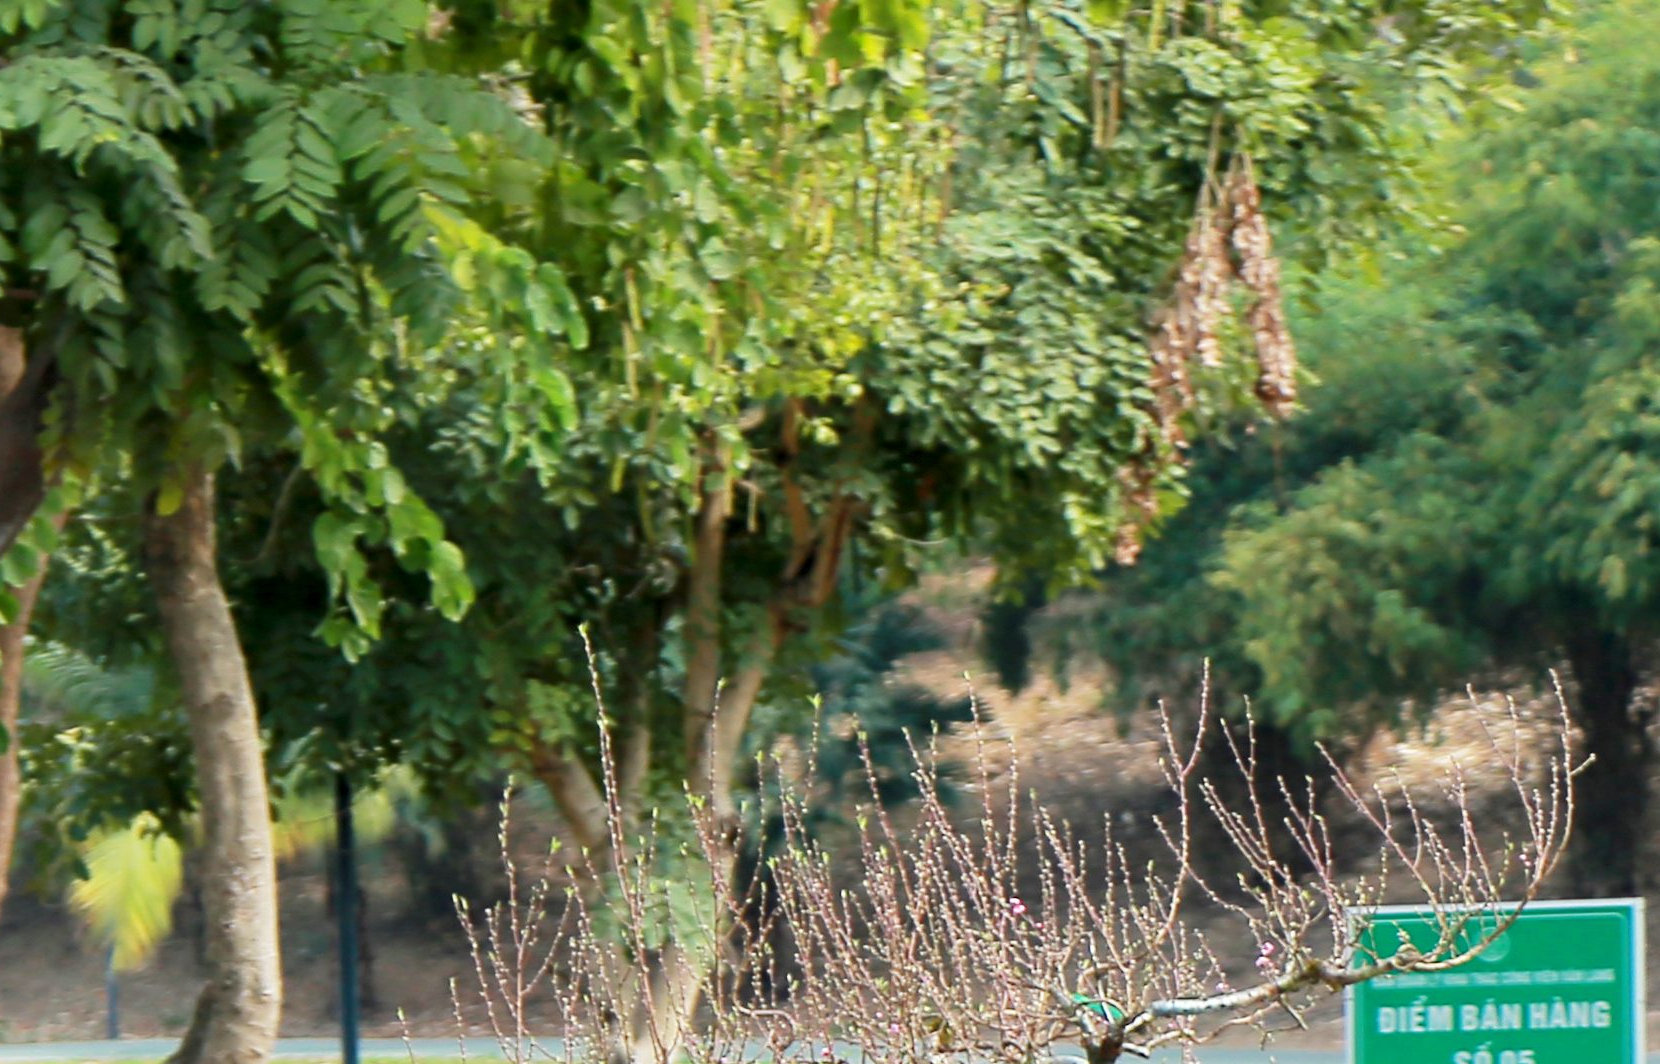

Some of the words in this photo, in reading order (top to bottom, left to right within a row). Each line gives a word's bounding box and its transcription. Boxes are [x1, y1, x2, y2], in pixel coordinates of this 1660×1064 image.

[1376, 995, 1454, 1034] ĐIỂM
[1459, 998, 1522, 1031] BÁN
[1528, 996, 1612, 1030] HÀNG
